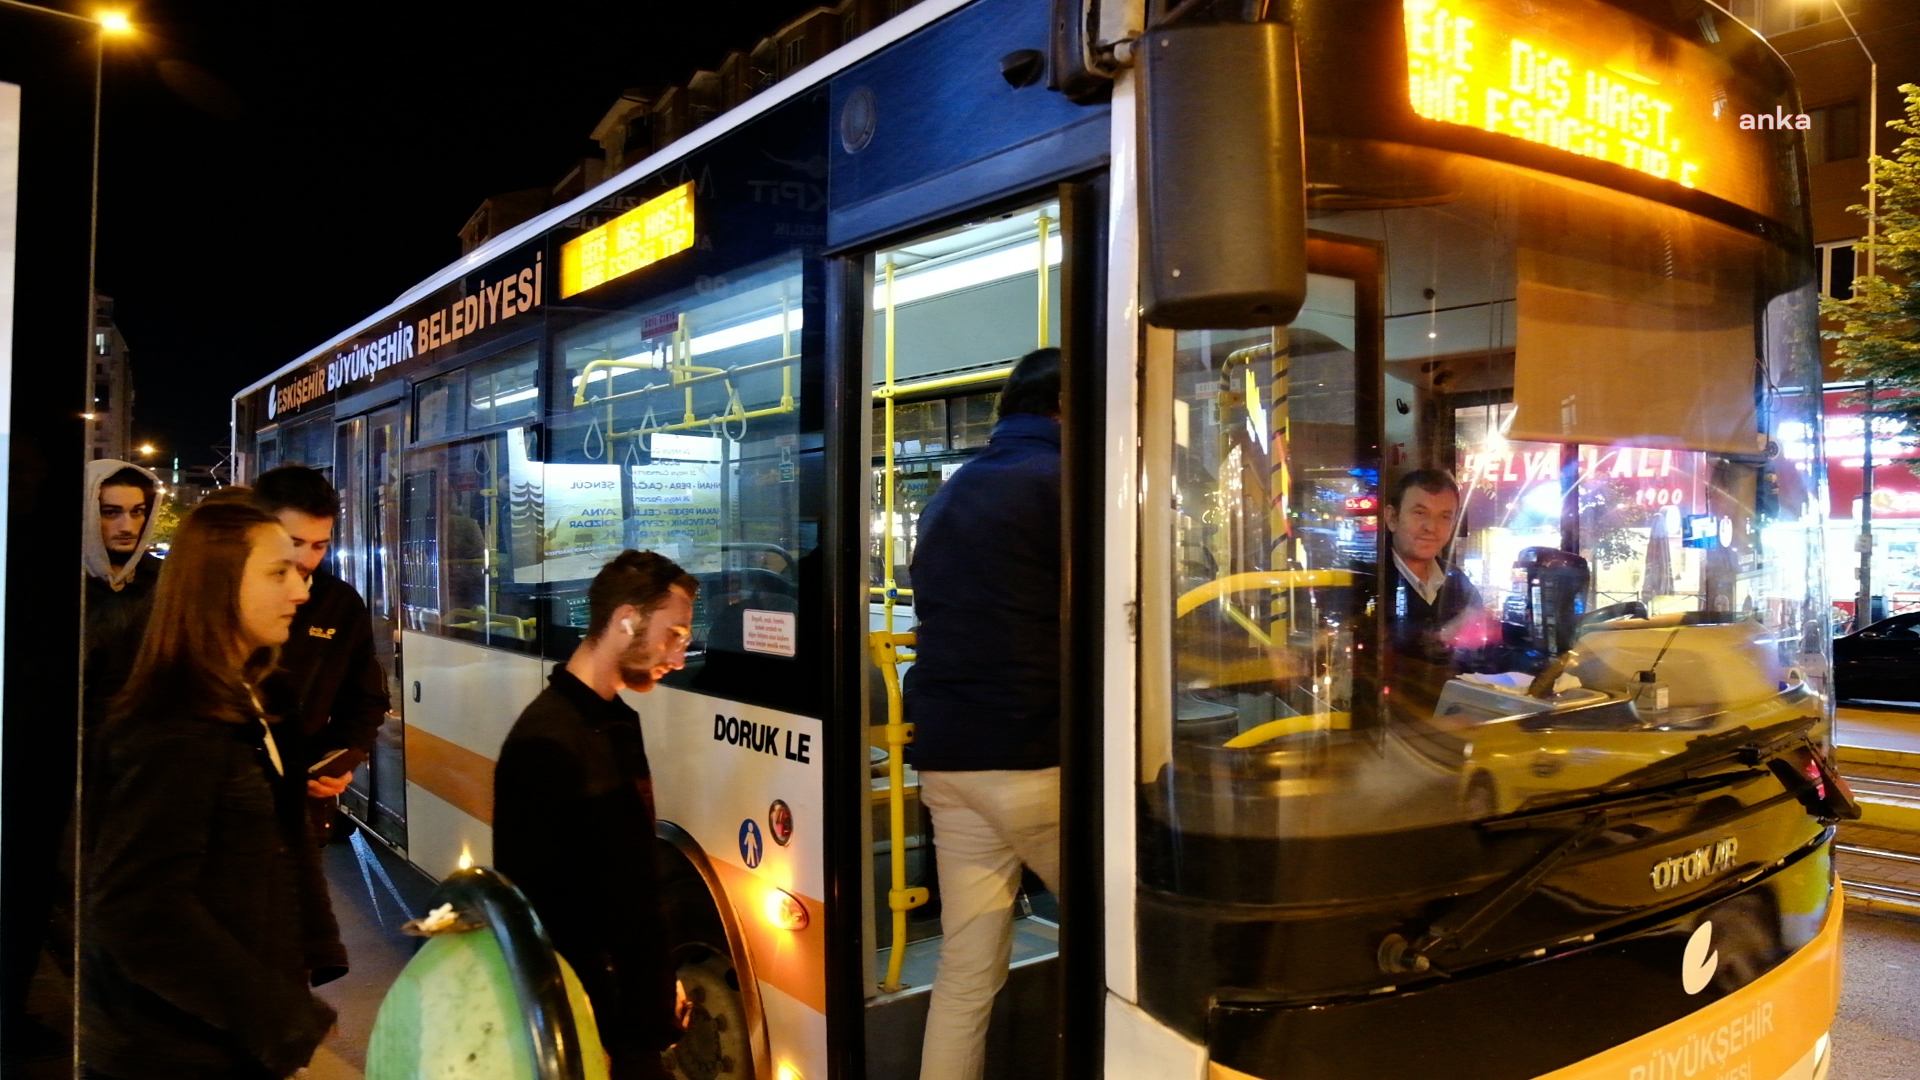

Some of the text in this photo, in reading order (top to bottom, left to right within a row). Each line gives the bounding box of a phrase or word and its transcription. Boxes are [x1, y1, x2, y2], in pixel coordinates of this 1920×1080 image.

[276, 250, 543, 414] ESKİŞEHİR BÜYÜKŞEHİR BELEDİYESİ
[1635, 488, 1683, 506] 1900
[714, 713, 811, 765] DORUK LE
[1650, 836, 1739, 892] OTOKAR
